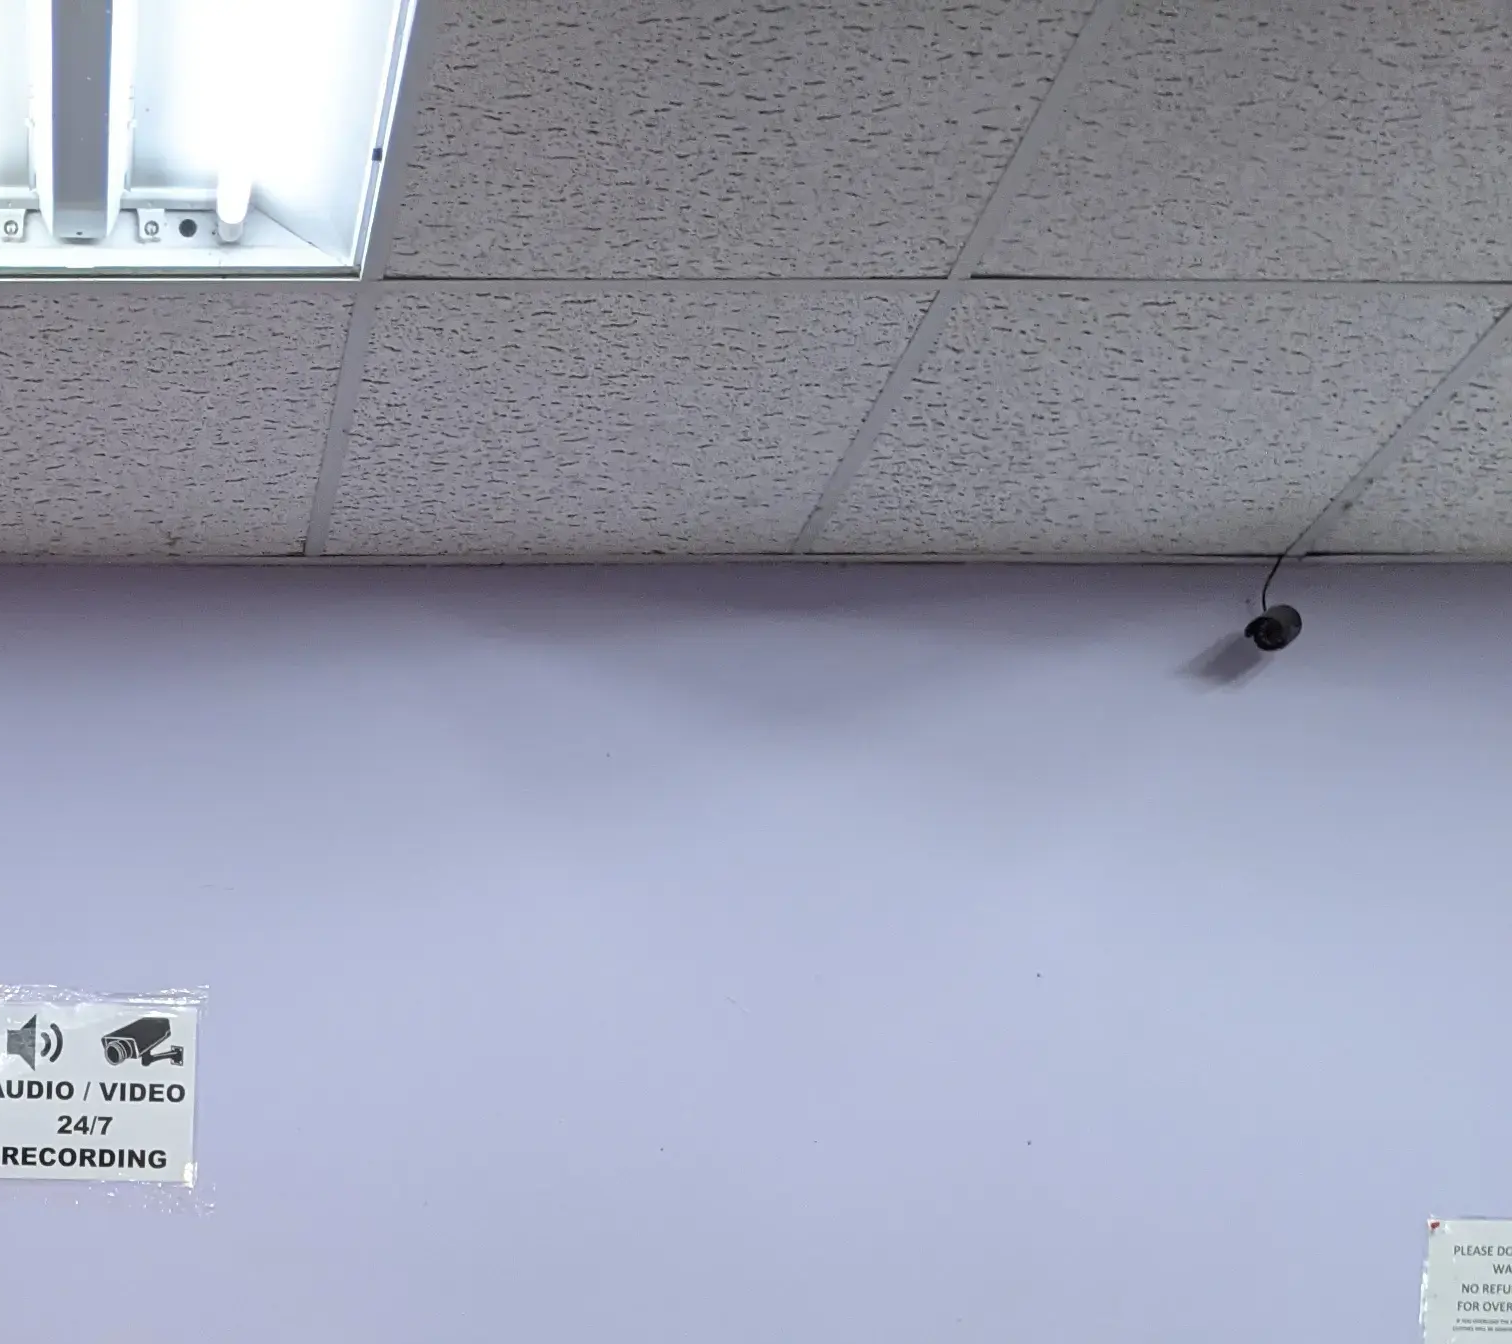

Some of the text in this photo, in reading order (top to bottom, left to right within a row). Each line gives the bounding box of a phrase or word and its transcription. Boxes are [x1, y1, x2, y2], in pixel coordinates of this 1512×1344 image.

[83, 1082, 91, 1101] /
[99, 1082, 186, 1103] VIDEO
[57, 1115, 113, 1135] 24/7
[1, 1146, 167, 1169] RECORDING
[1454, 1245, 1493, 1256] PLEASE
[1462, 1283, 1512, 1294] NO REFU
[1458, 1301, 1479, 1312] FOR
